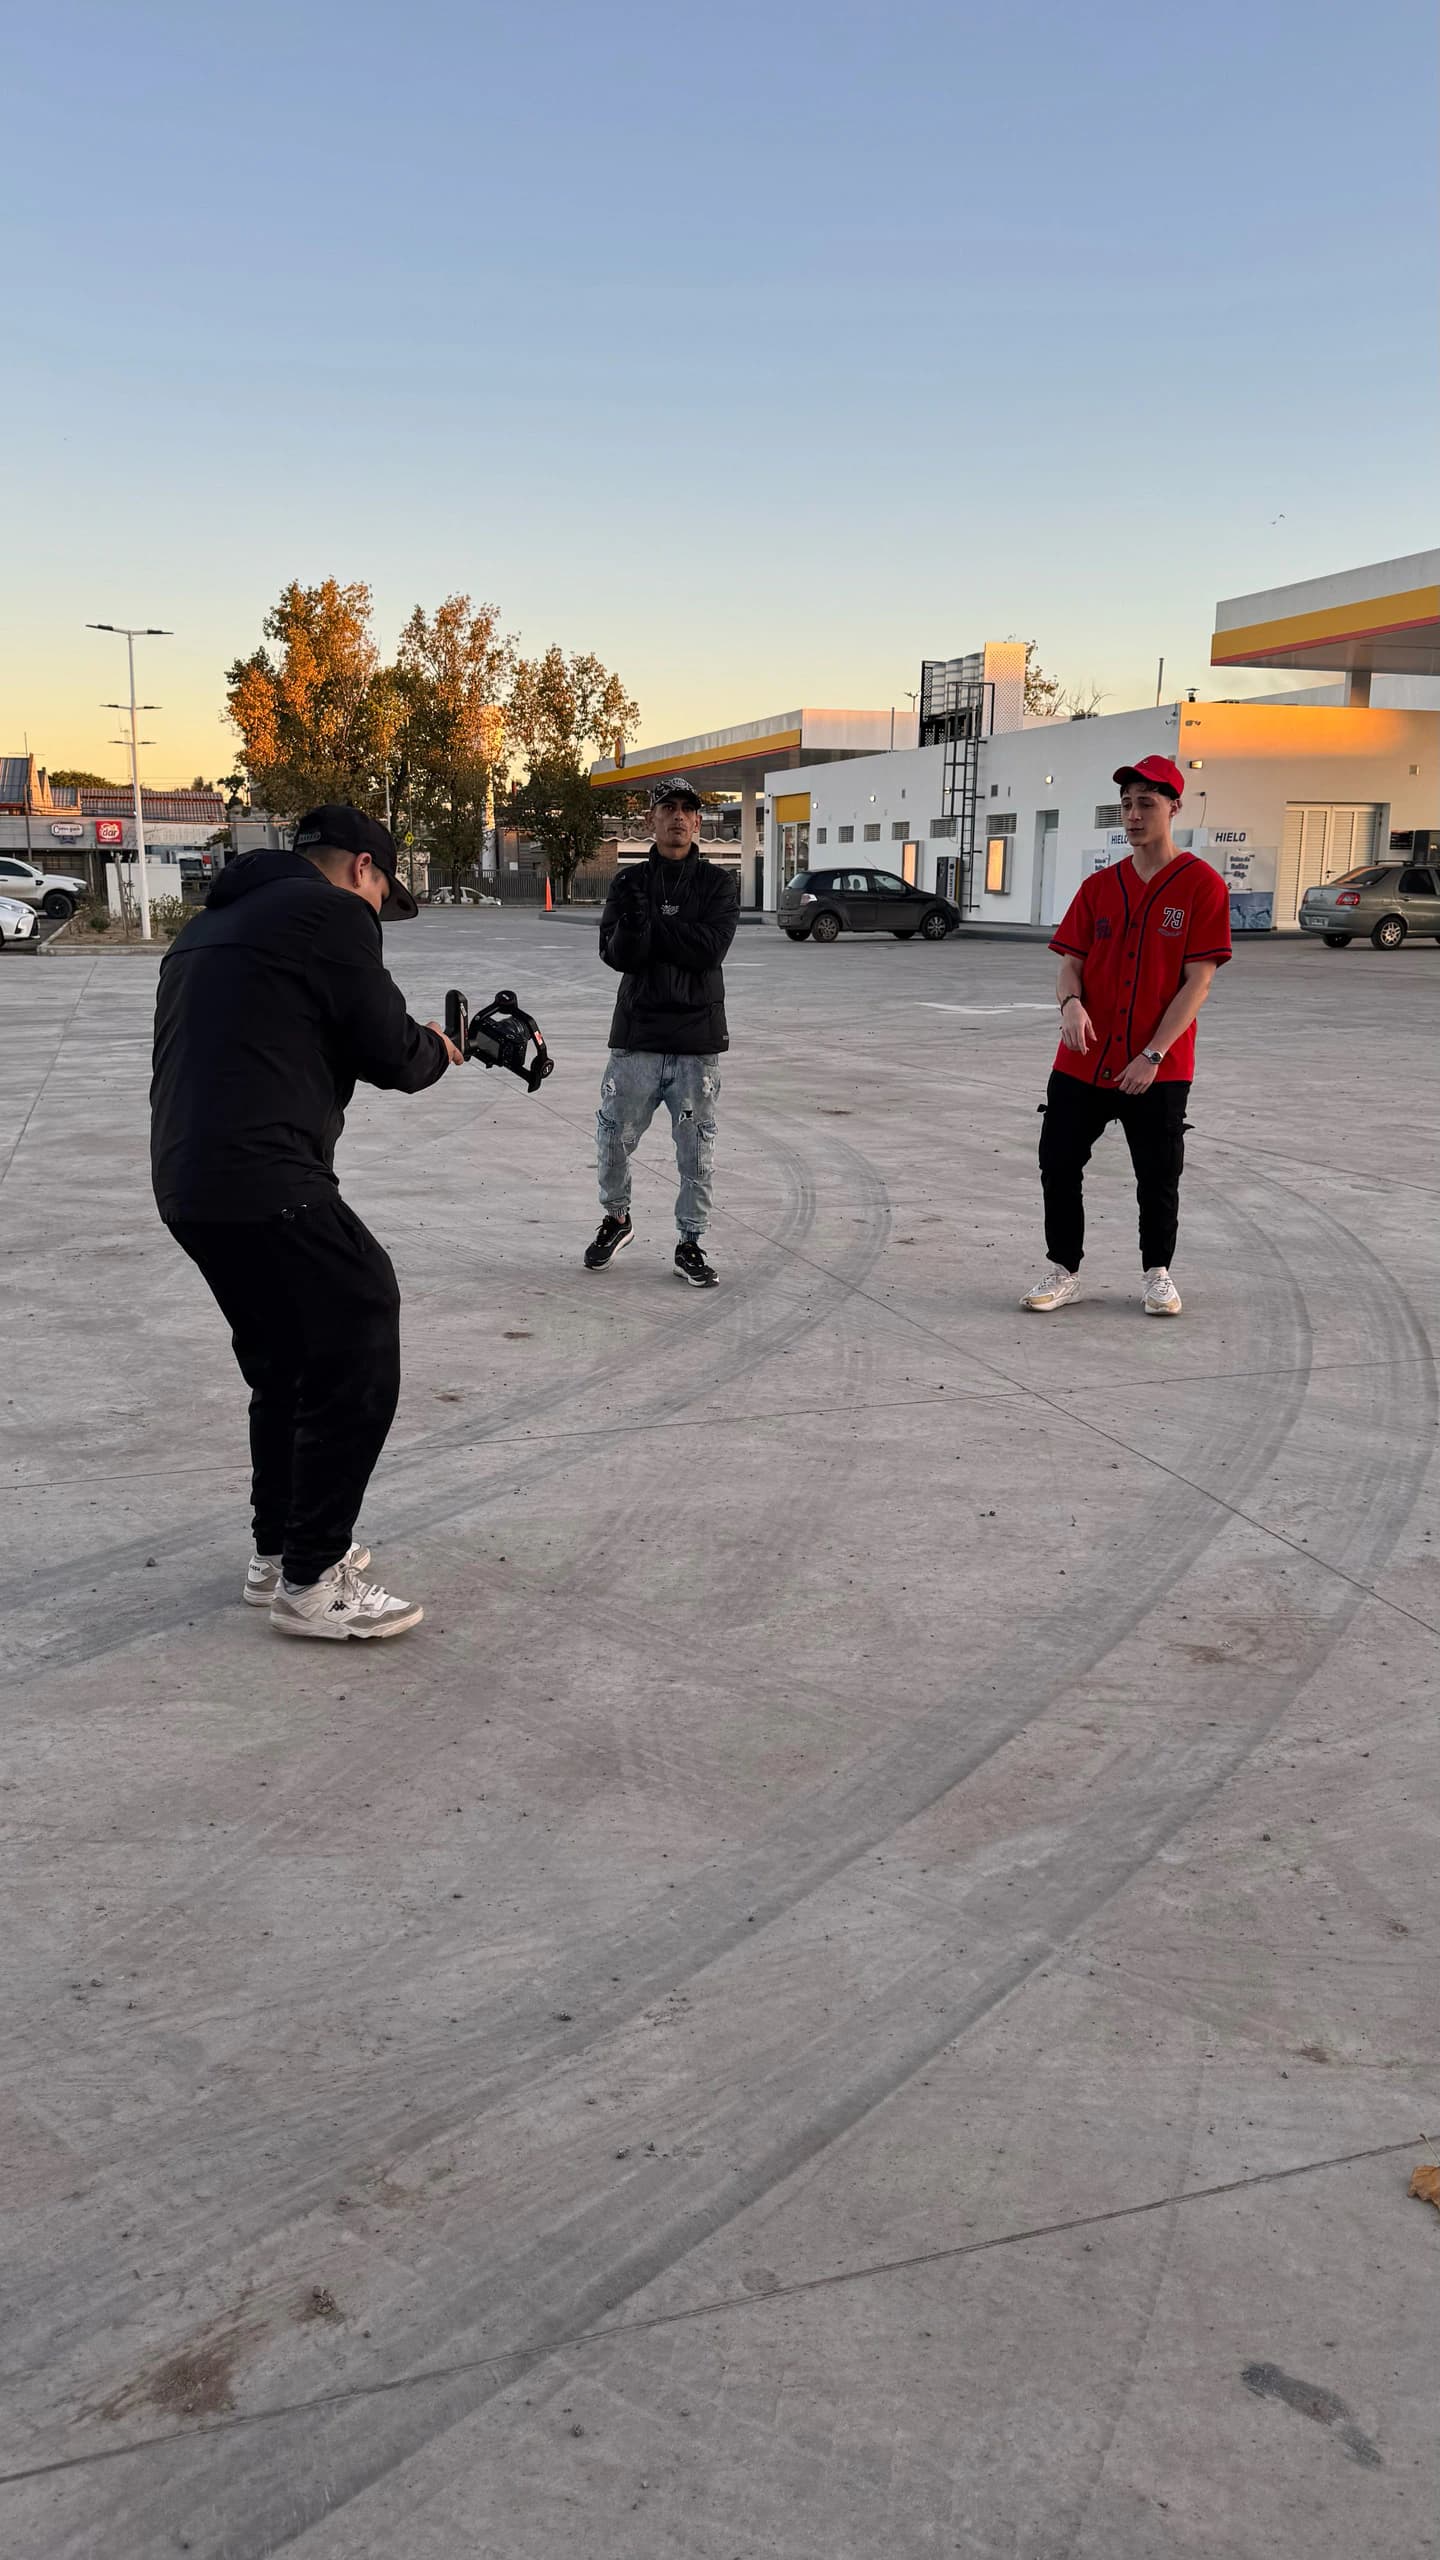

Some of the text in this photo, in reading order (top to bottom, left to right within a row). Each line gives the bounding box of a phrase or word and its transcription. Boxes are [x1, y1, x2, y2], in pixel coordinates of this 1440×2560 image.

[1111, 834, 1128, 844] HIELO
[1215, 831, 1246, 842] HIELO
[1162, 906, 1185, 929] 79
